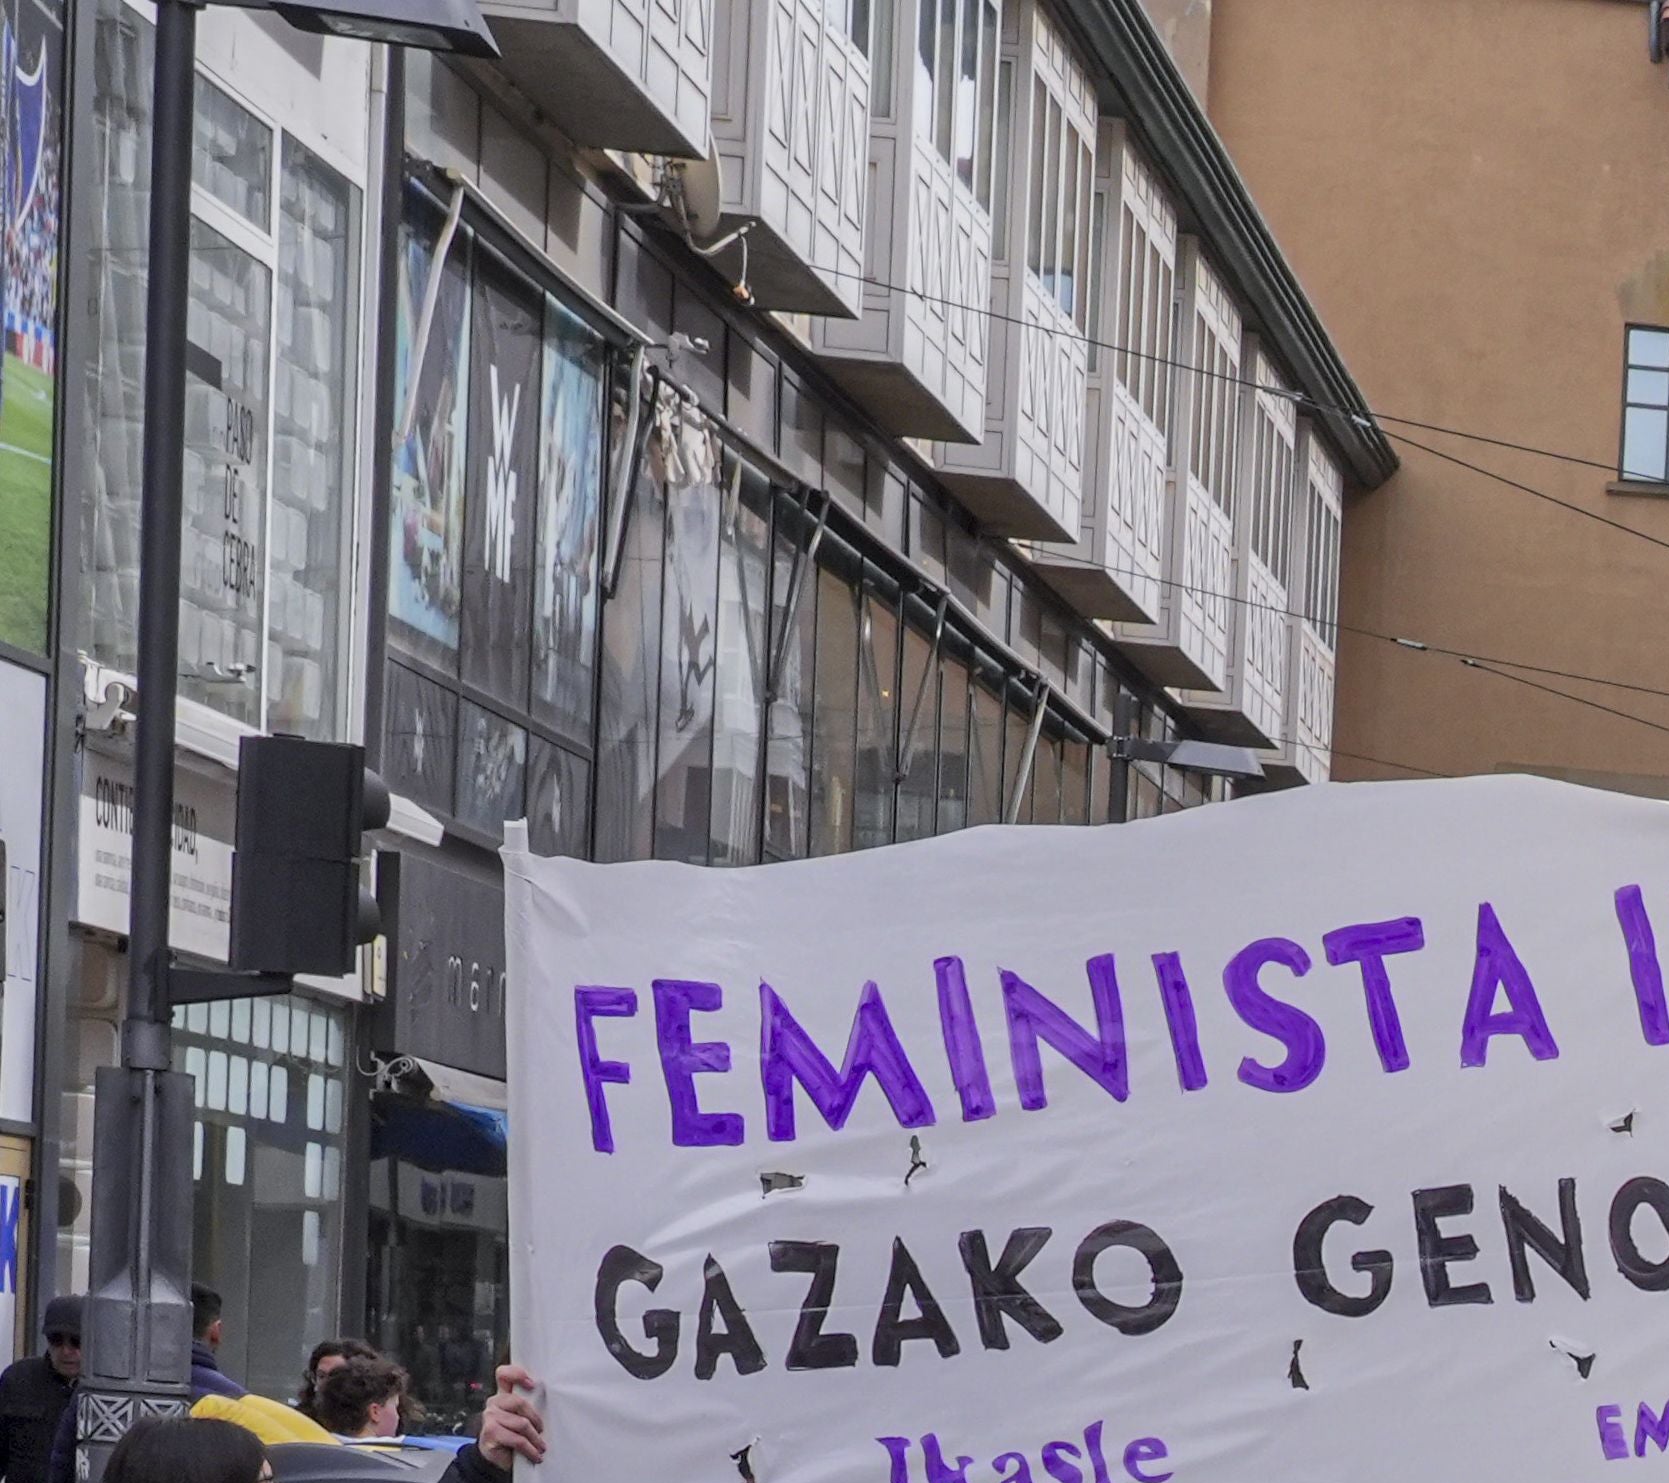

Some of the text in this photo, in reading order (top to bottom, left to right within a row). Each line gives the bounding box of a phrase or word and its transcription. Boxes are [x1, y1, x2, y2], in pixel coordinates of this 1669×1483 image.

[225, 397, 253, 465] PASO
[224, 463, 238, 524] DE
[222, 530, 256, 600] CEBRA
[572, 900, 1561, 1154] FEMINISTA
[595, 1217, 1184, 1382] GAZAKO
